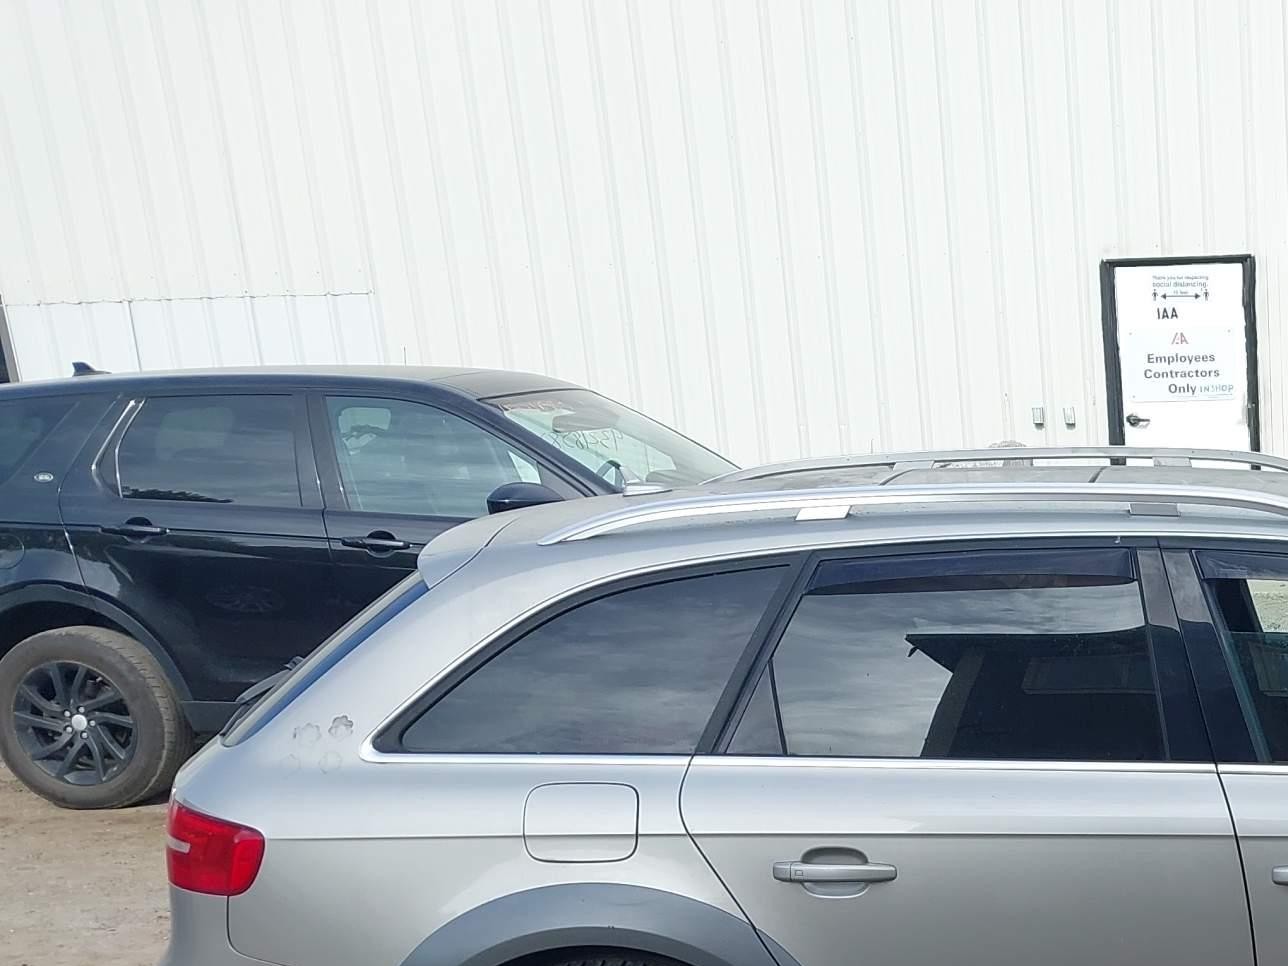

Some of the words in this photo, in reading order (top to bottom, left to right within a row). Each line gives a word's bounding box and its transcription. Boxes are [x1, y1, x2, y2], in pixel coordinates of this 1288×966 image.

[1157, 307, 1178, 320] IAA
[1147, 353, 1216, 365] Employees
[1144, 368, 1220, 379] Contractors
[1168, 383, 1197, 395] Only
